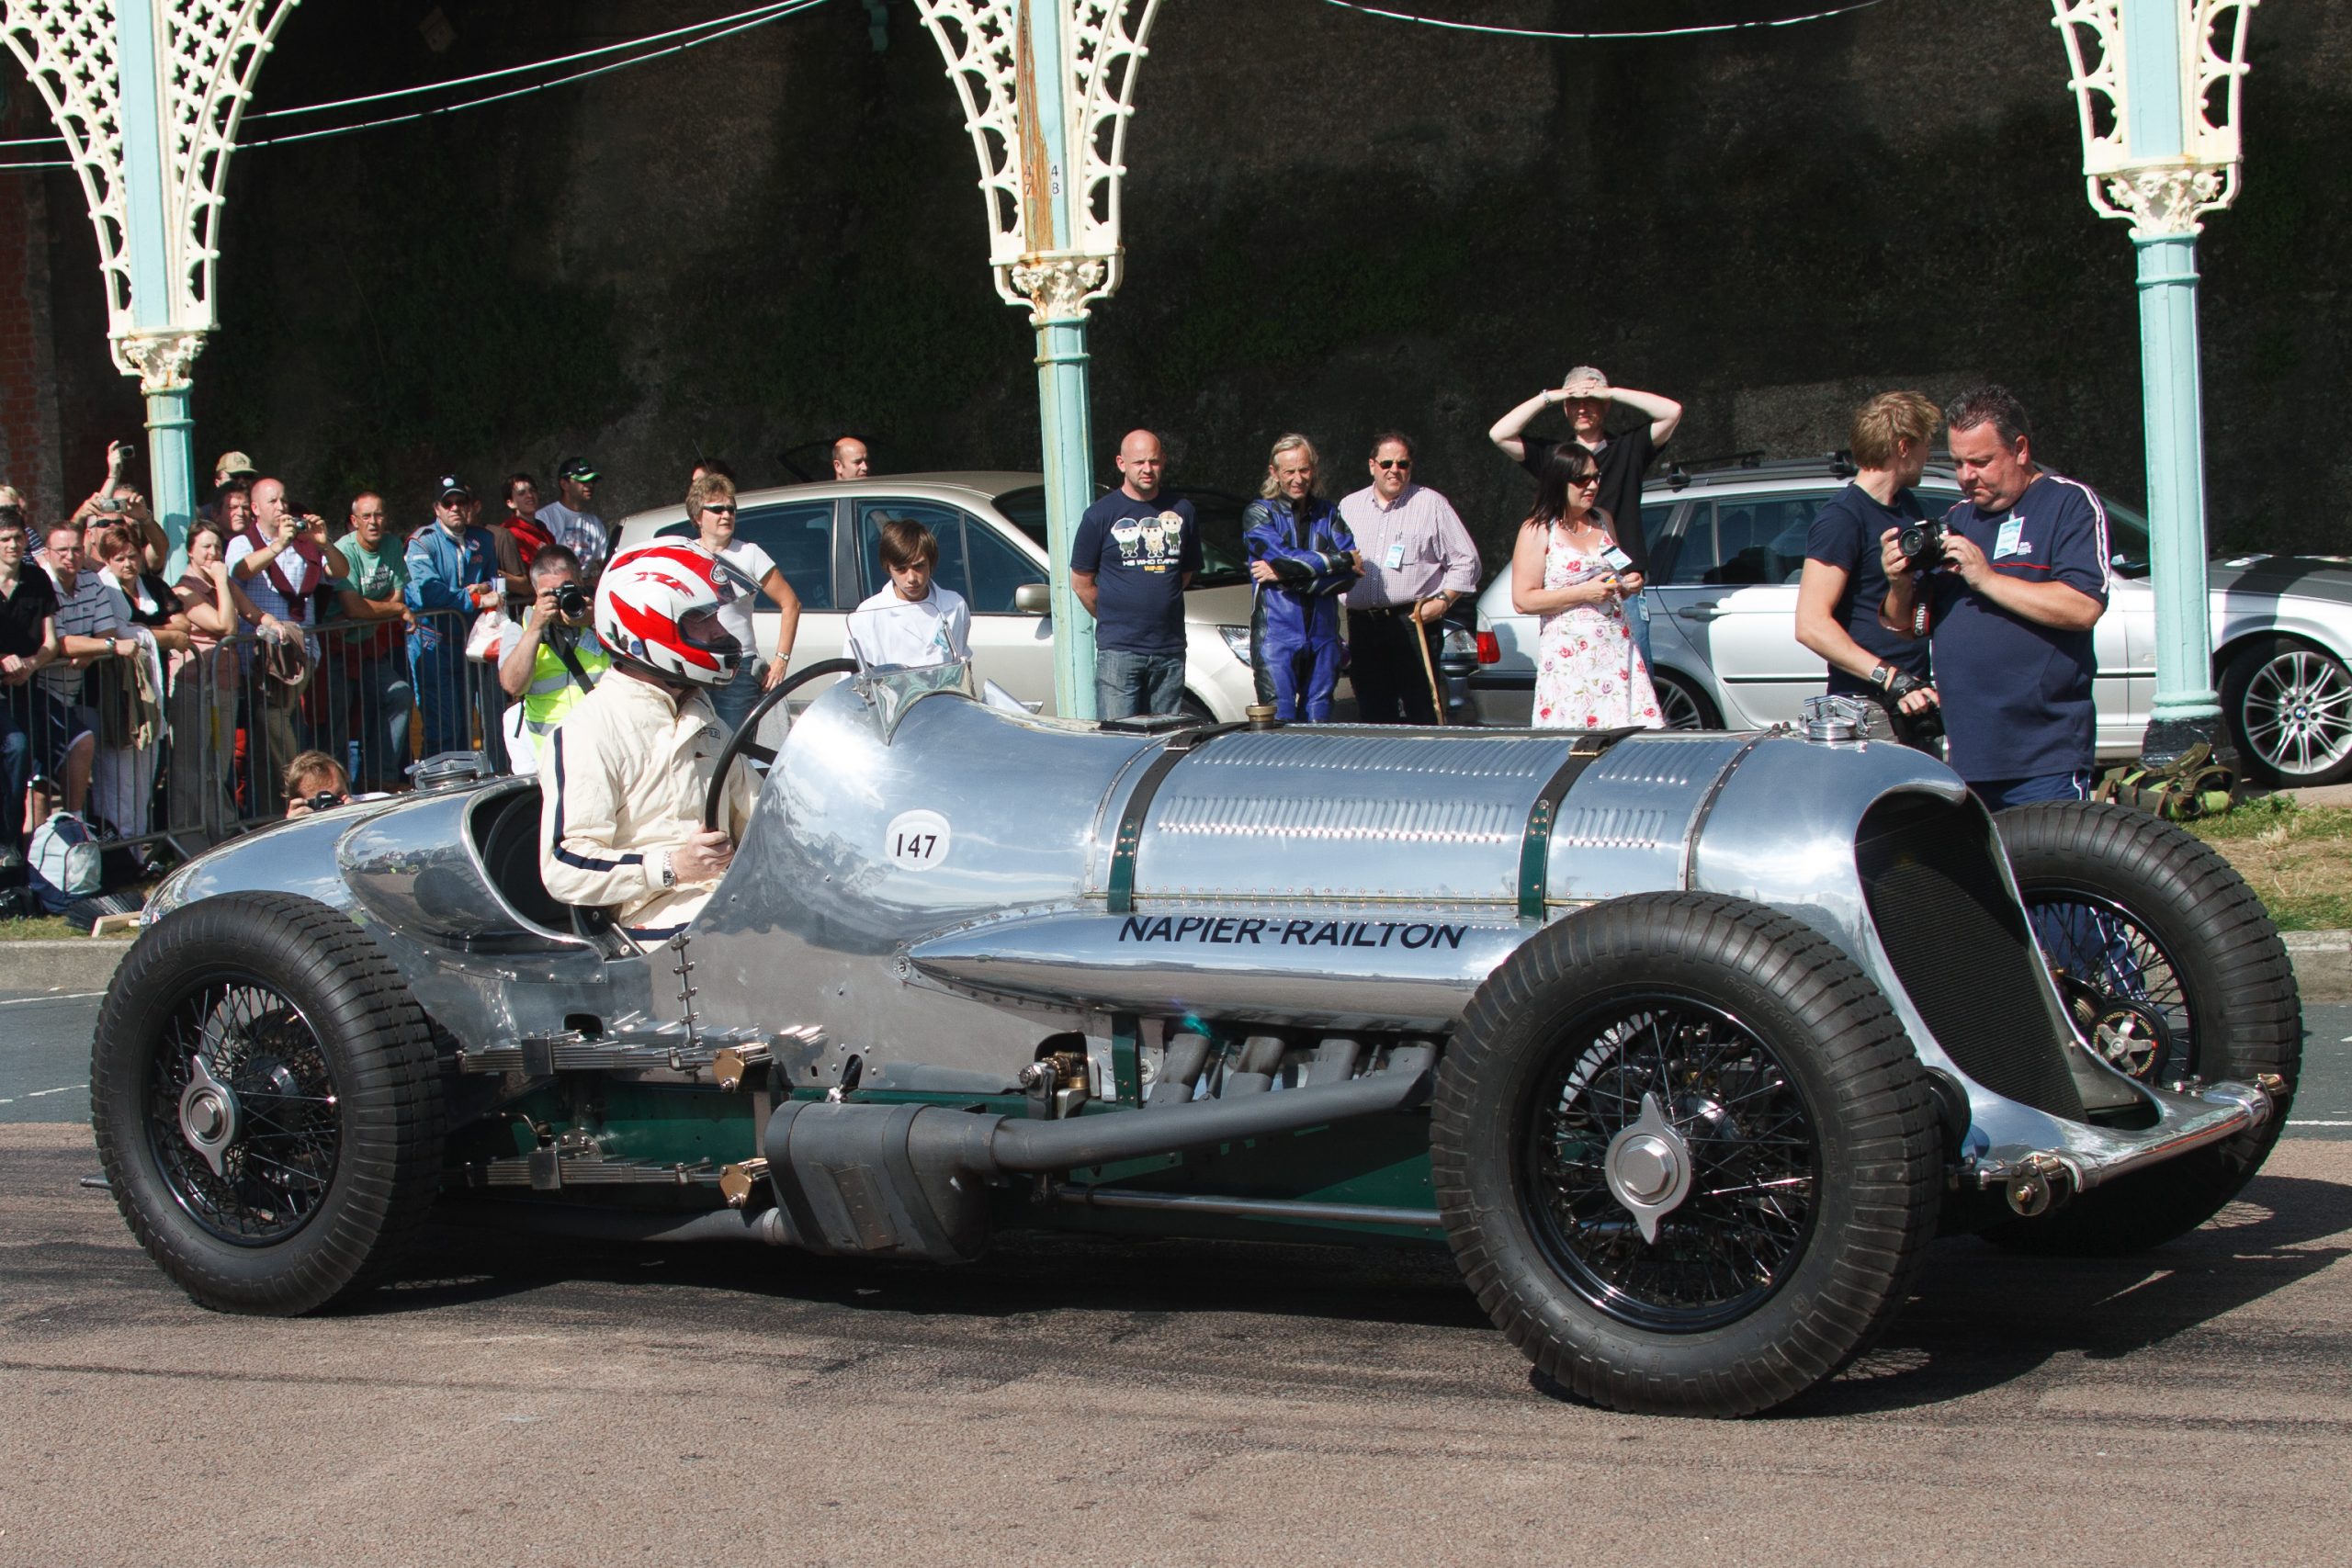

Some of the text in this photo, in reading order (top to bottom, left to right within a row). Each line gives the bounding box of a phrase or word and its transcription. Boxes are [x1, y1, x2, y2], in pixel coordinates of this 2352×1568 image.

[1915, 603, 1926, 636] Canon
[897, 833, 937, 859] 147
[1118, 917, 1468, 949] NAPIER-RAILTON
